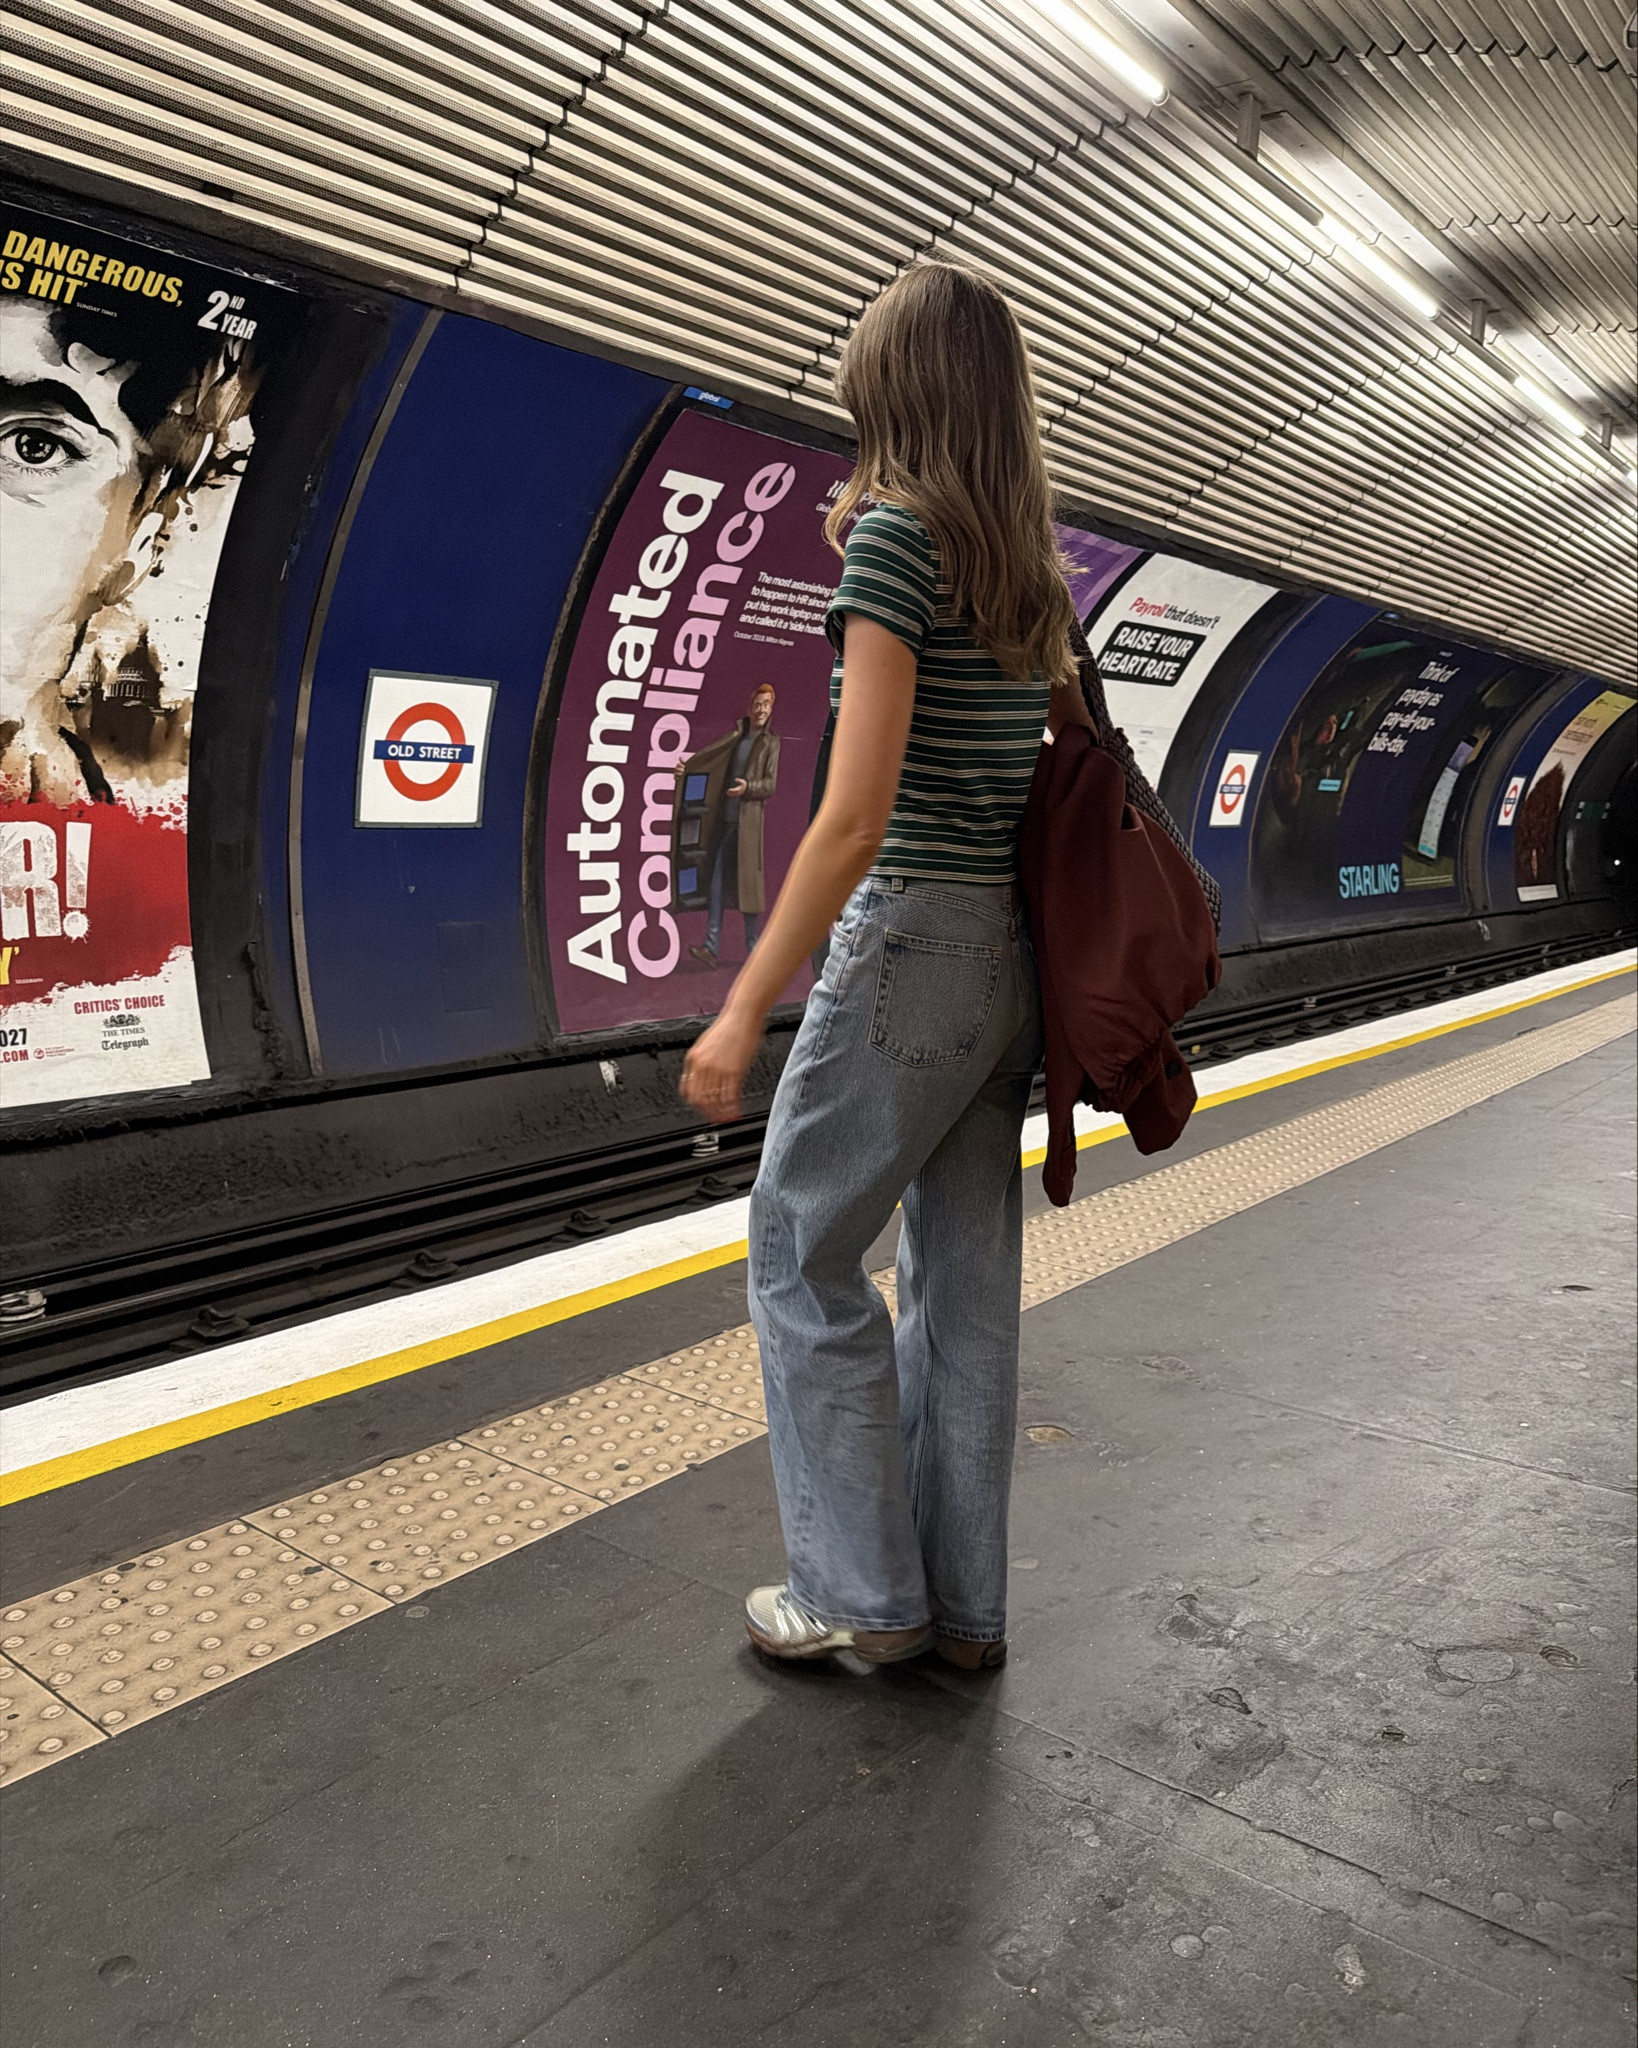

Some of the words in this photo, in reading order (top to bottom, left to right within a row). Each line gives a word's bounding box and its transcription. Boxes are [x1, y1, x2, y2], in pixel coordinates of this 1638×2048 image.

[2, 230, 184, 307] DANGEROUS,
[220, 313, 258, 340] YEAR
[751, 586, 760, 596] to
[759, 586, 788, 601] happen
[788, 592, 796, 603] to
[796, 594, 810, 605] HR
[808, 596, 827, 608] since
[758, 571, 773, 584] The
[772, 577, 792, 588] most
[791, 581, 832, 597] astonishing
[739, 613, 756, 624] and
[755, 615, 778, 627] called
[777, 618, 783, 629] it
[782, 620, 789, 630] a
[744, 600, 760, 611] put
[759, 601, 771, 612] his
[770, 605, 790, 615] work
[789, 606, 812, 620] laptop
[811, 612, 822, 621] on
[1129, 597, 1169, 617] Payroll
[1164, 605, 1189, 622] that
[1183, 609, 1221, 630] doesn't
[1113, 626, 1162, 652] RAISE
[1155, 634, 1194, 658] YOUR
[1097, 650, 1149, 676] HEART
[1418, 661, 1449, 682] Think
[567, 469, 726, 984] Automated
[627, 461, 796, 978] Compliance
[387, 744, 415, 757] OLD
[418, 746, 462, 760] STREET
[1339, 862, 1400, 899] STARLING
[74, 998, 122, 1015] CRITICS'
[124, 995, 165, 1010] CHOICE
[101, 1037, 149, 1051] Telegraph
[102, 1029, 119, 1037] THE
[119, 1027, 145, 1037] TIMES
